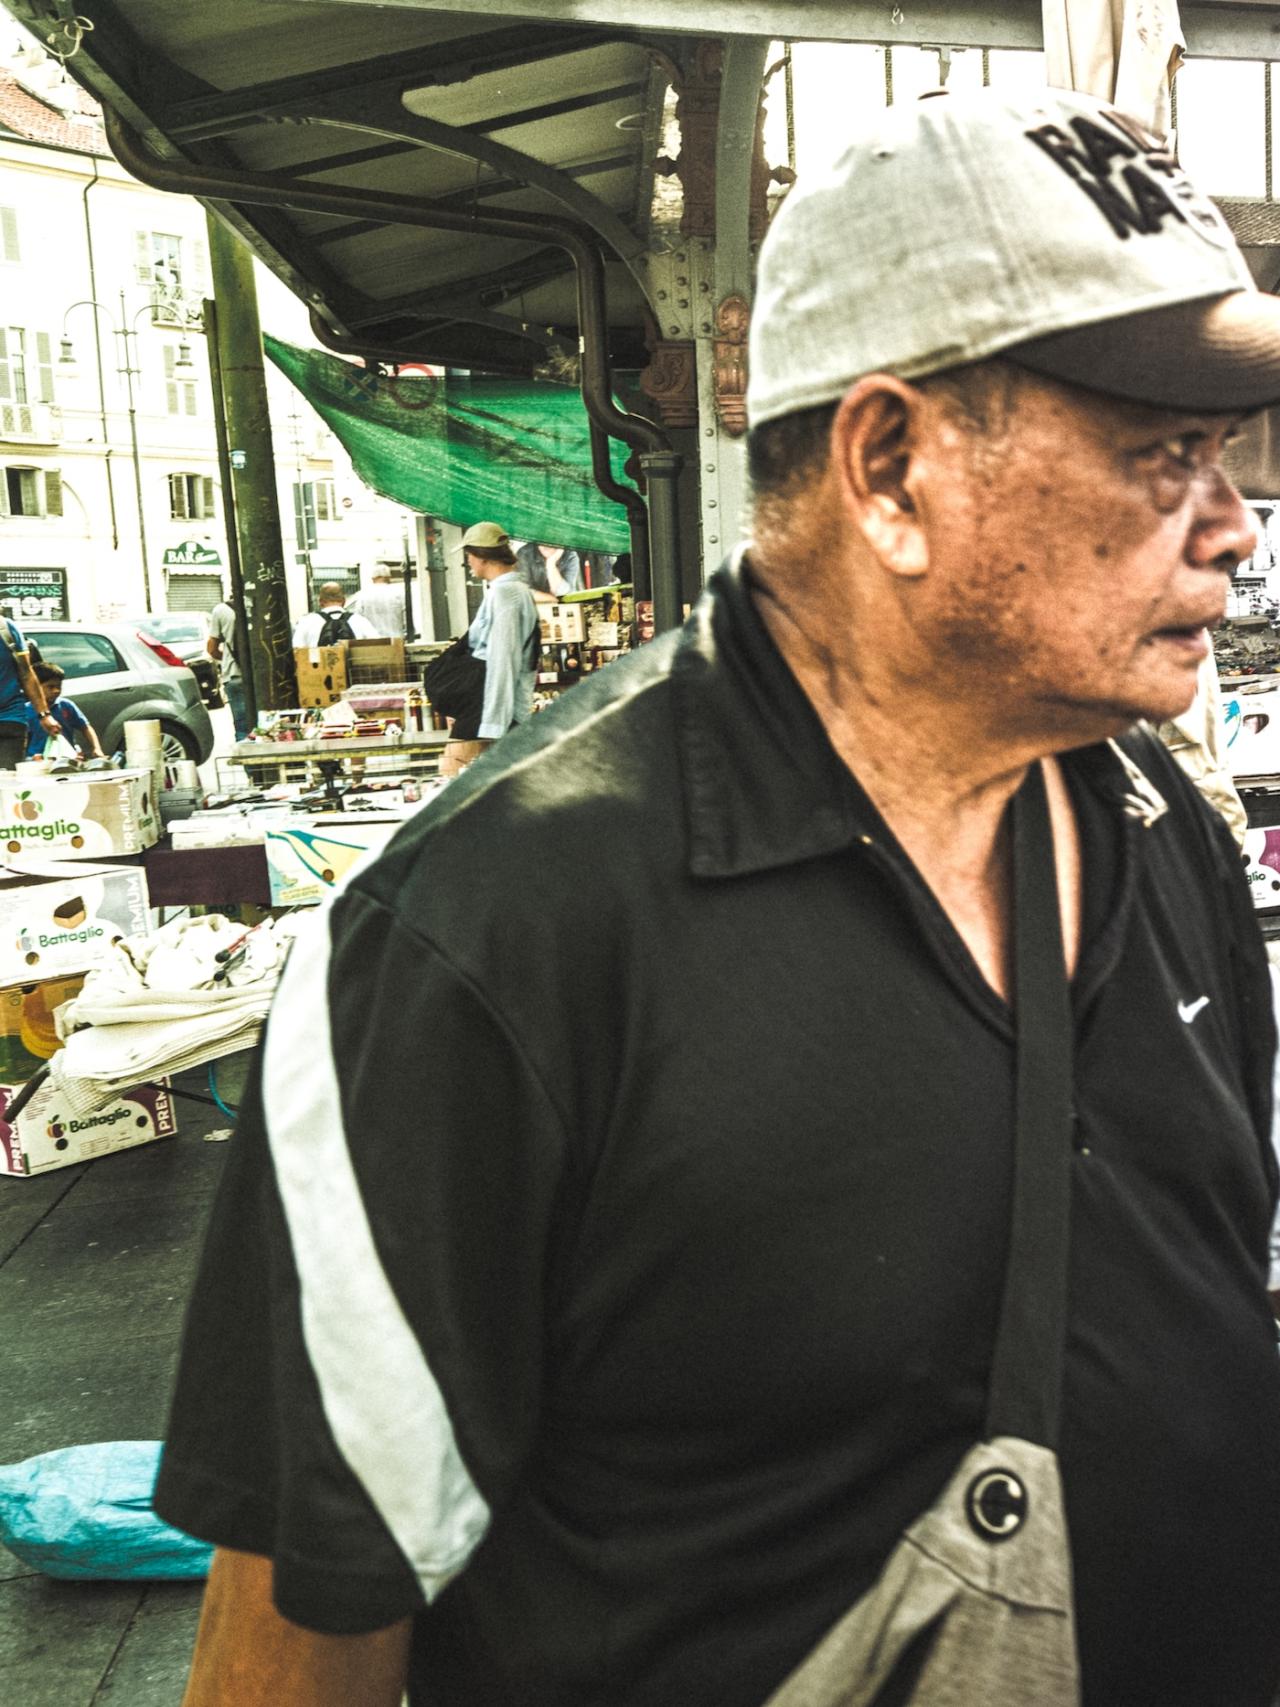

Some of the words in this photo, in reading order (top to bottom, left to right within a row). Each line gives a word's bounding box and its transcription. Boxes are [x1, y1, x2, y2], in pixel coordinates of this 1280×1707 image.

[168, 551, 194, 563] BAR
[119, 783, 136, 849] PREMIUM
[39, 926, 104, 947] Battaglio
[69, 1107, 131, 1133] Battaglio
